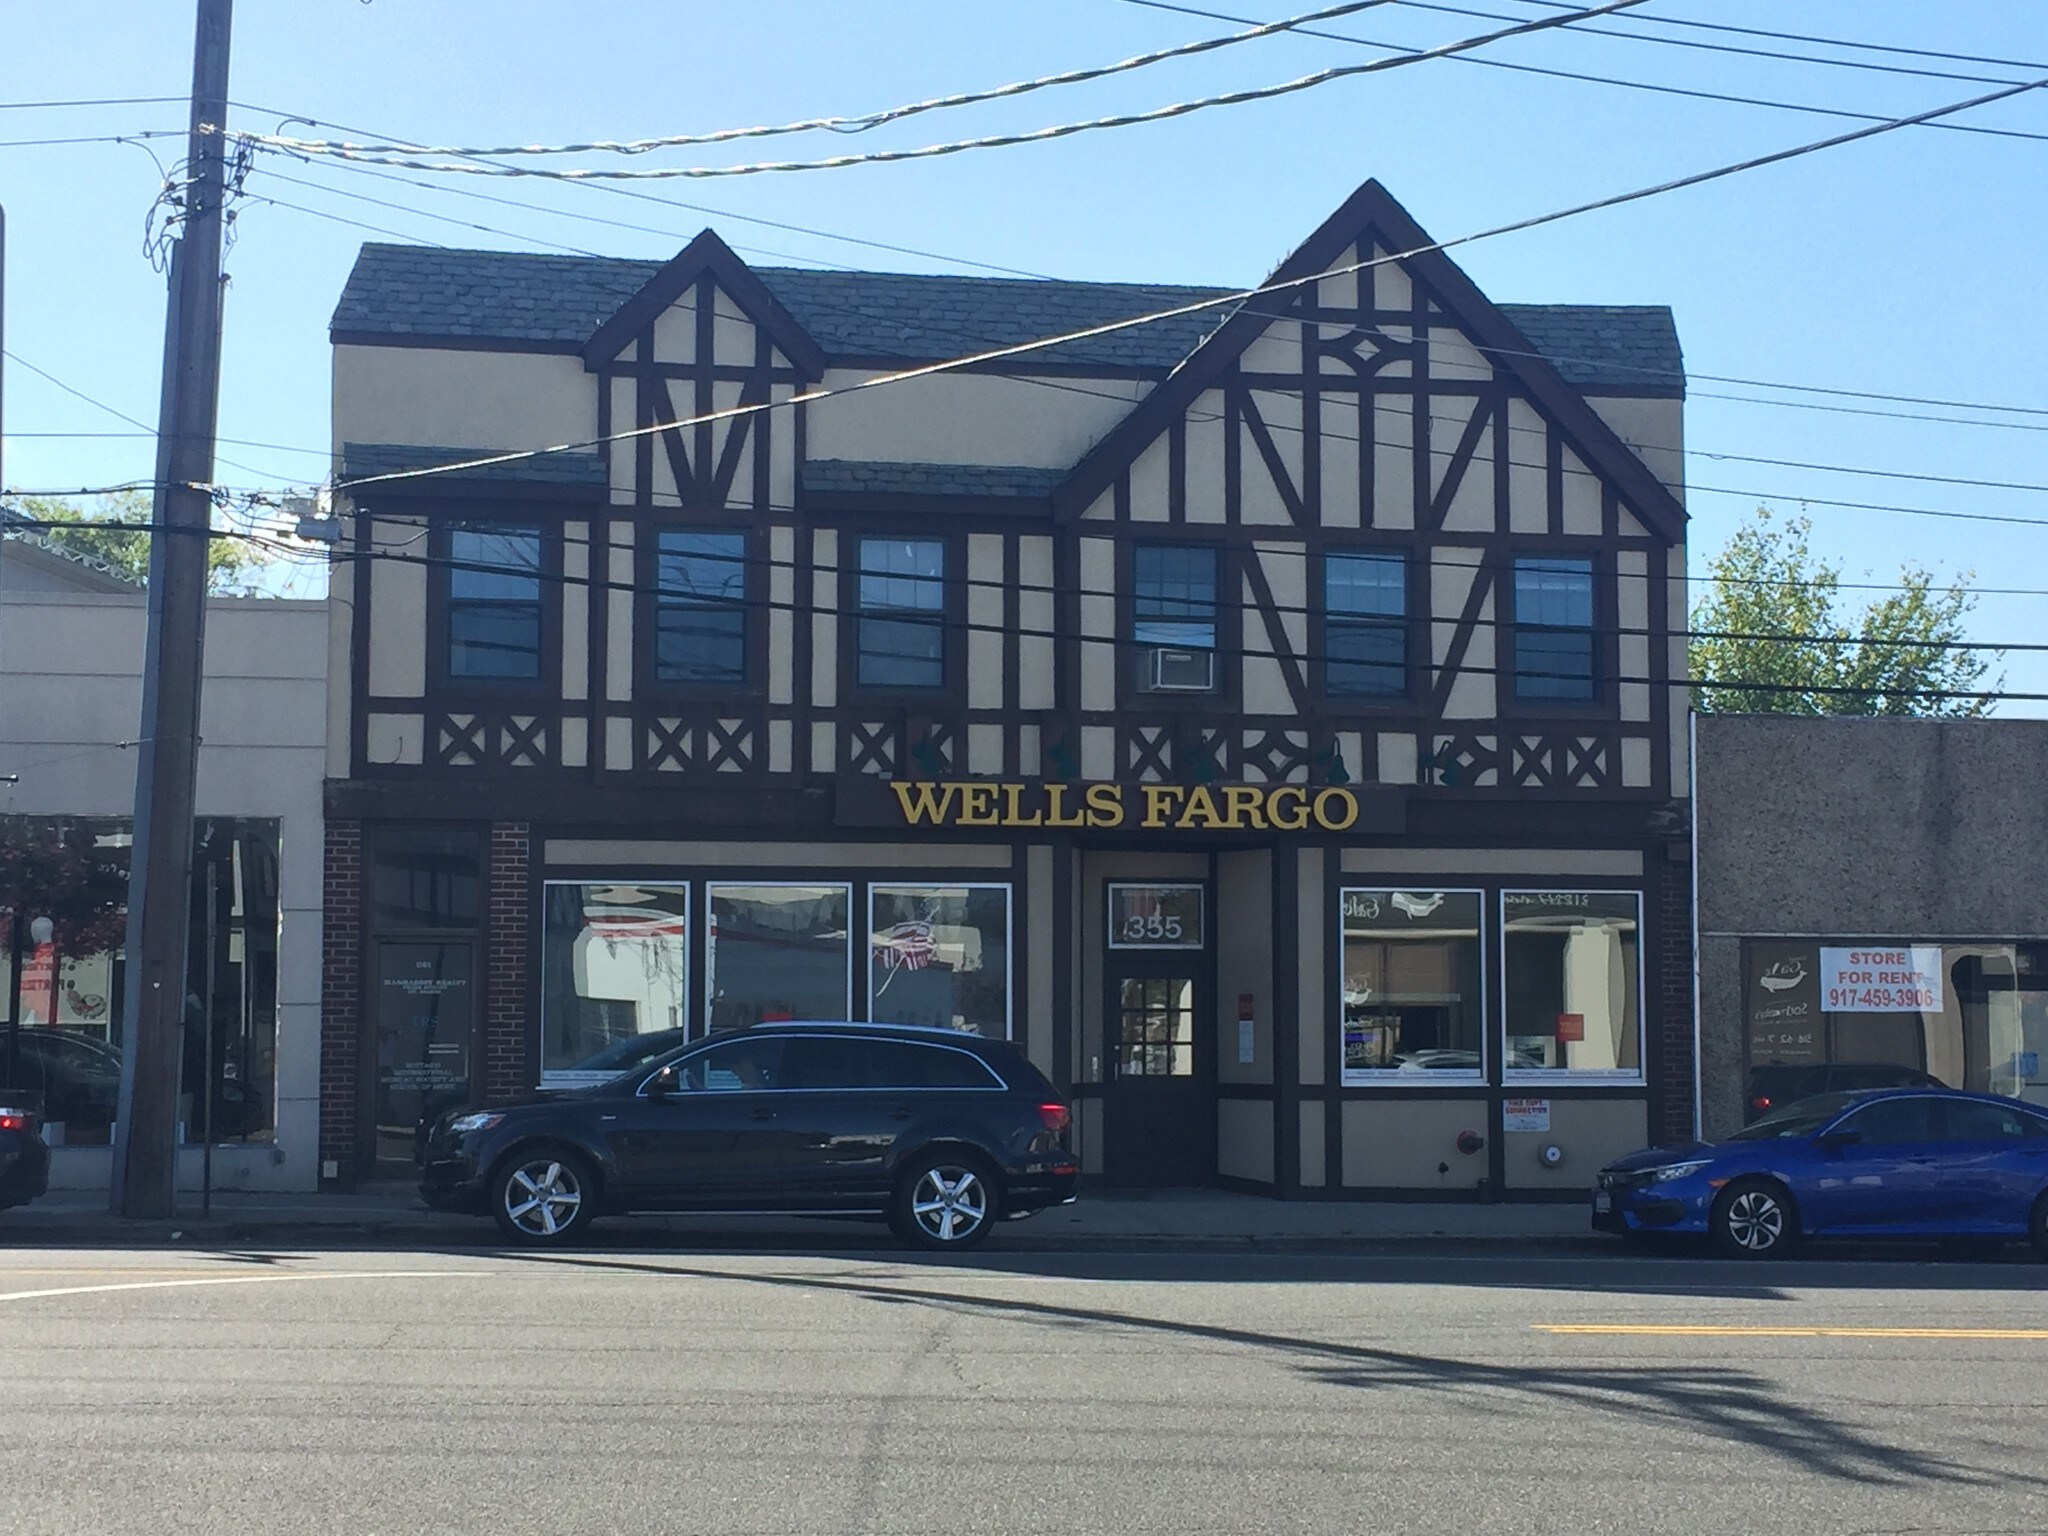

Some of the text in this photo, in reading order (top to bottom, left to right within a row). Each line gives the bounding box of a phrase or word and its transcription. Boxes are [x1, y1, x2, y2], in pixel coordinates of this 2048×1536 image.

[890, 781, 1360, 831] WELLS FARGO
[1128, 915, 1183, 939] 355
[1849, 952, 1907, 965] STORE
[1837, 971, 1924, 985] FOR RENT
[1829, 987, 1934, 1008] 917-459-3906
